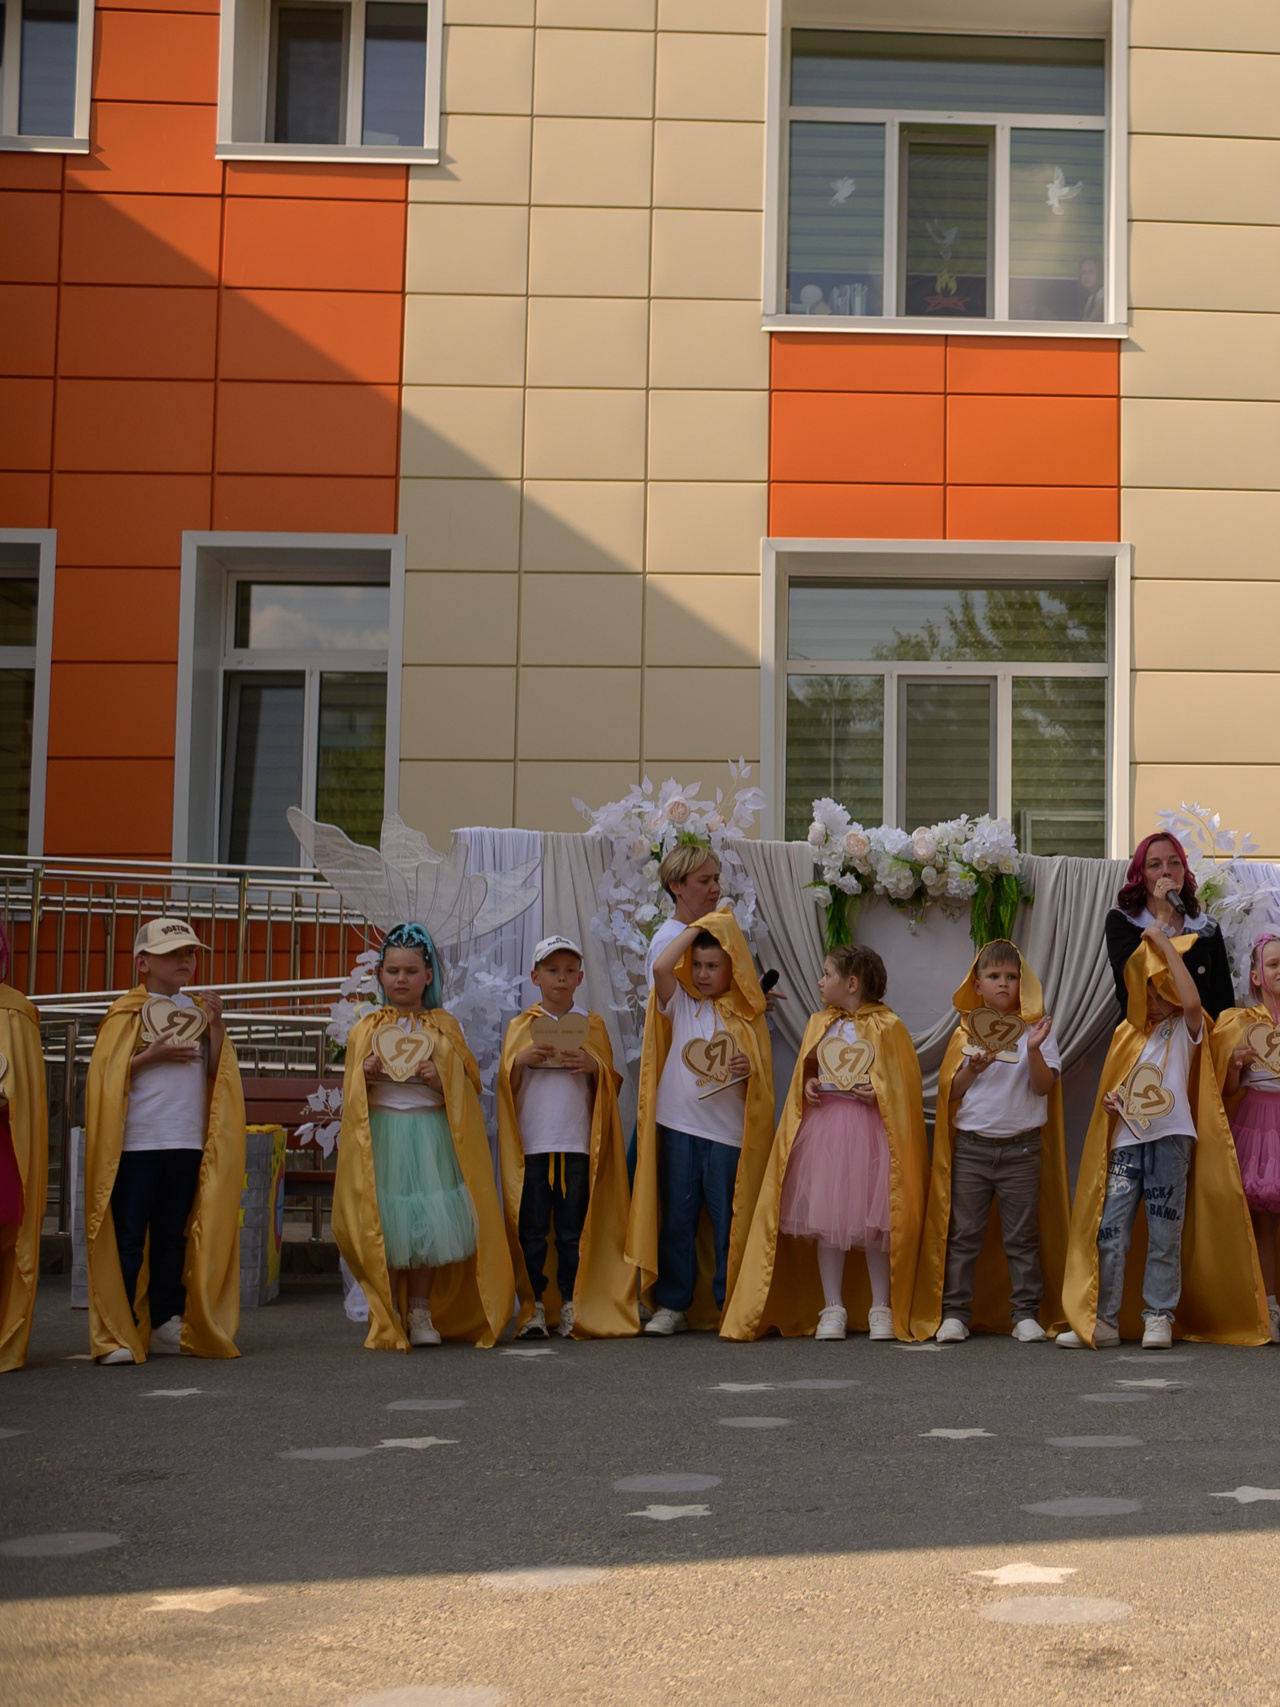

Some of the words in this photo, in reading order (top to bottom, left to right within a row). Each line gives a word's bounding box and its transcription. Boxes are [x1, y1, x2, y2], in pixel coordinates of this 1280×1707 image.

[1111, 1149, 1135, 1165] EST
[1145, 1186, 1167, 1201] OCK
[1150, 1203, 1177, 1221] BAND
[1097, 1226, 1114, 1242] AR
